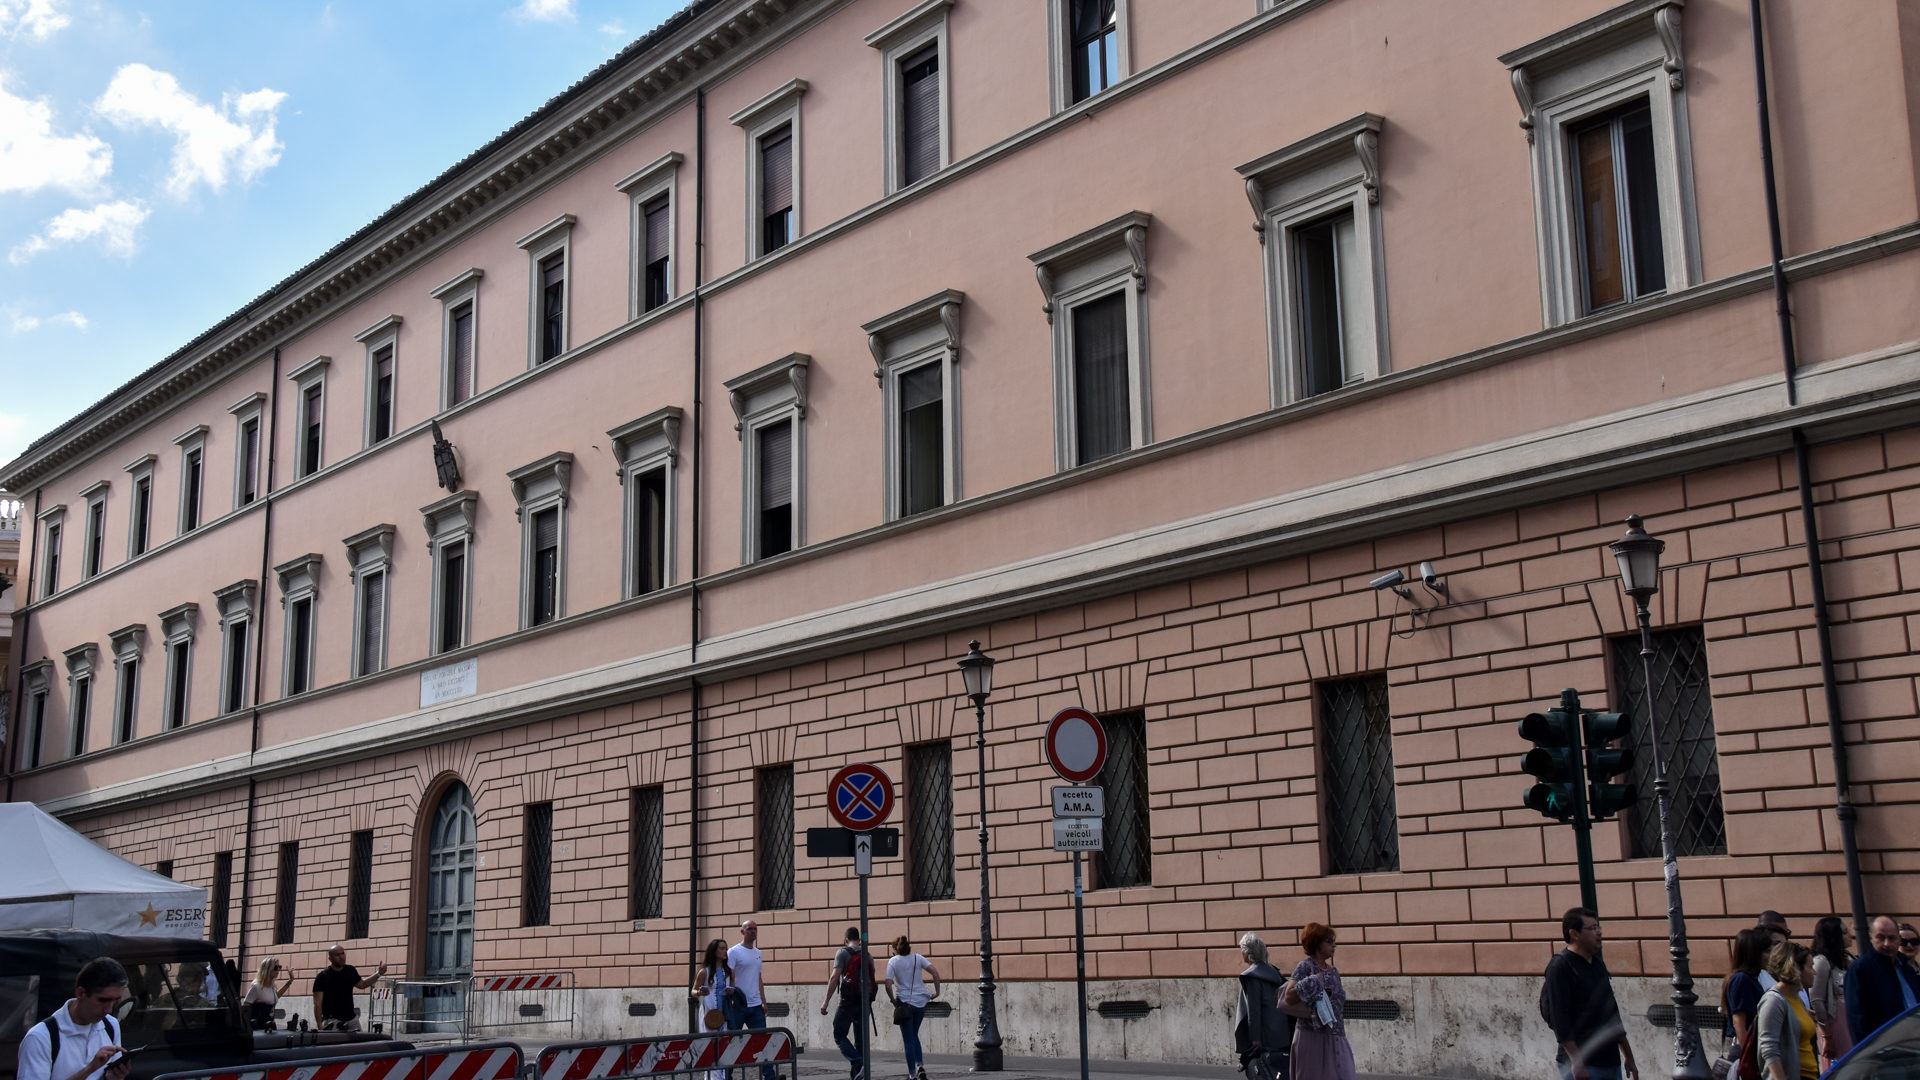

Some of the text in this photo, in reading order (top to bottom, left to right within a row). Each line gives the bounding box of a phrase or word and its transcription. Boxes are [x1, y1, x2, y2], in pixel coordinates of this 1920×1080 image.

[1062, 791, 1093, 799] eccetto
[1063, 803, 1095, 812] A.M.A.
[1065, 829, 1091, 838] veicoli
[1057, 839, 1100, 847] autorizzati
